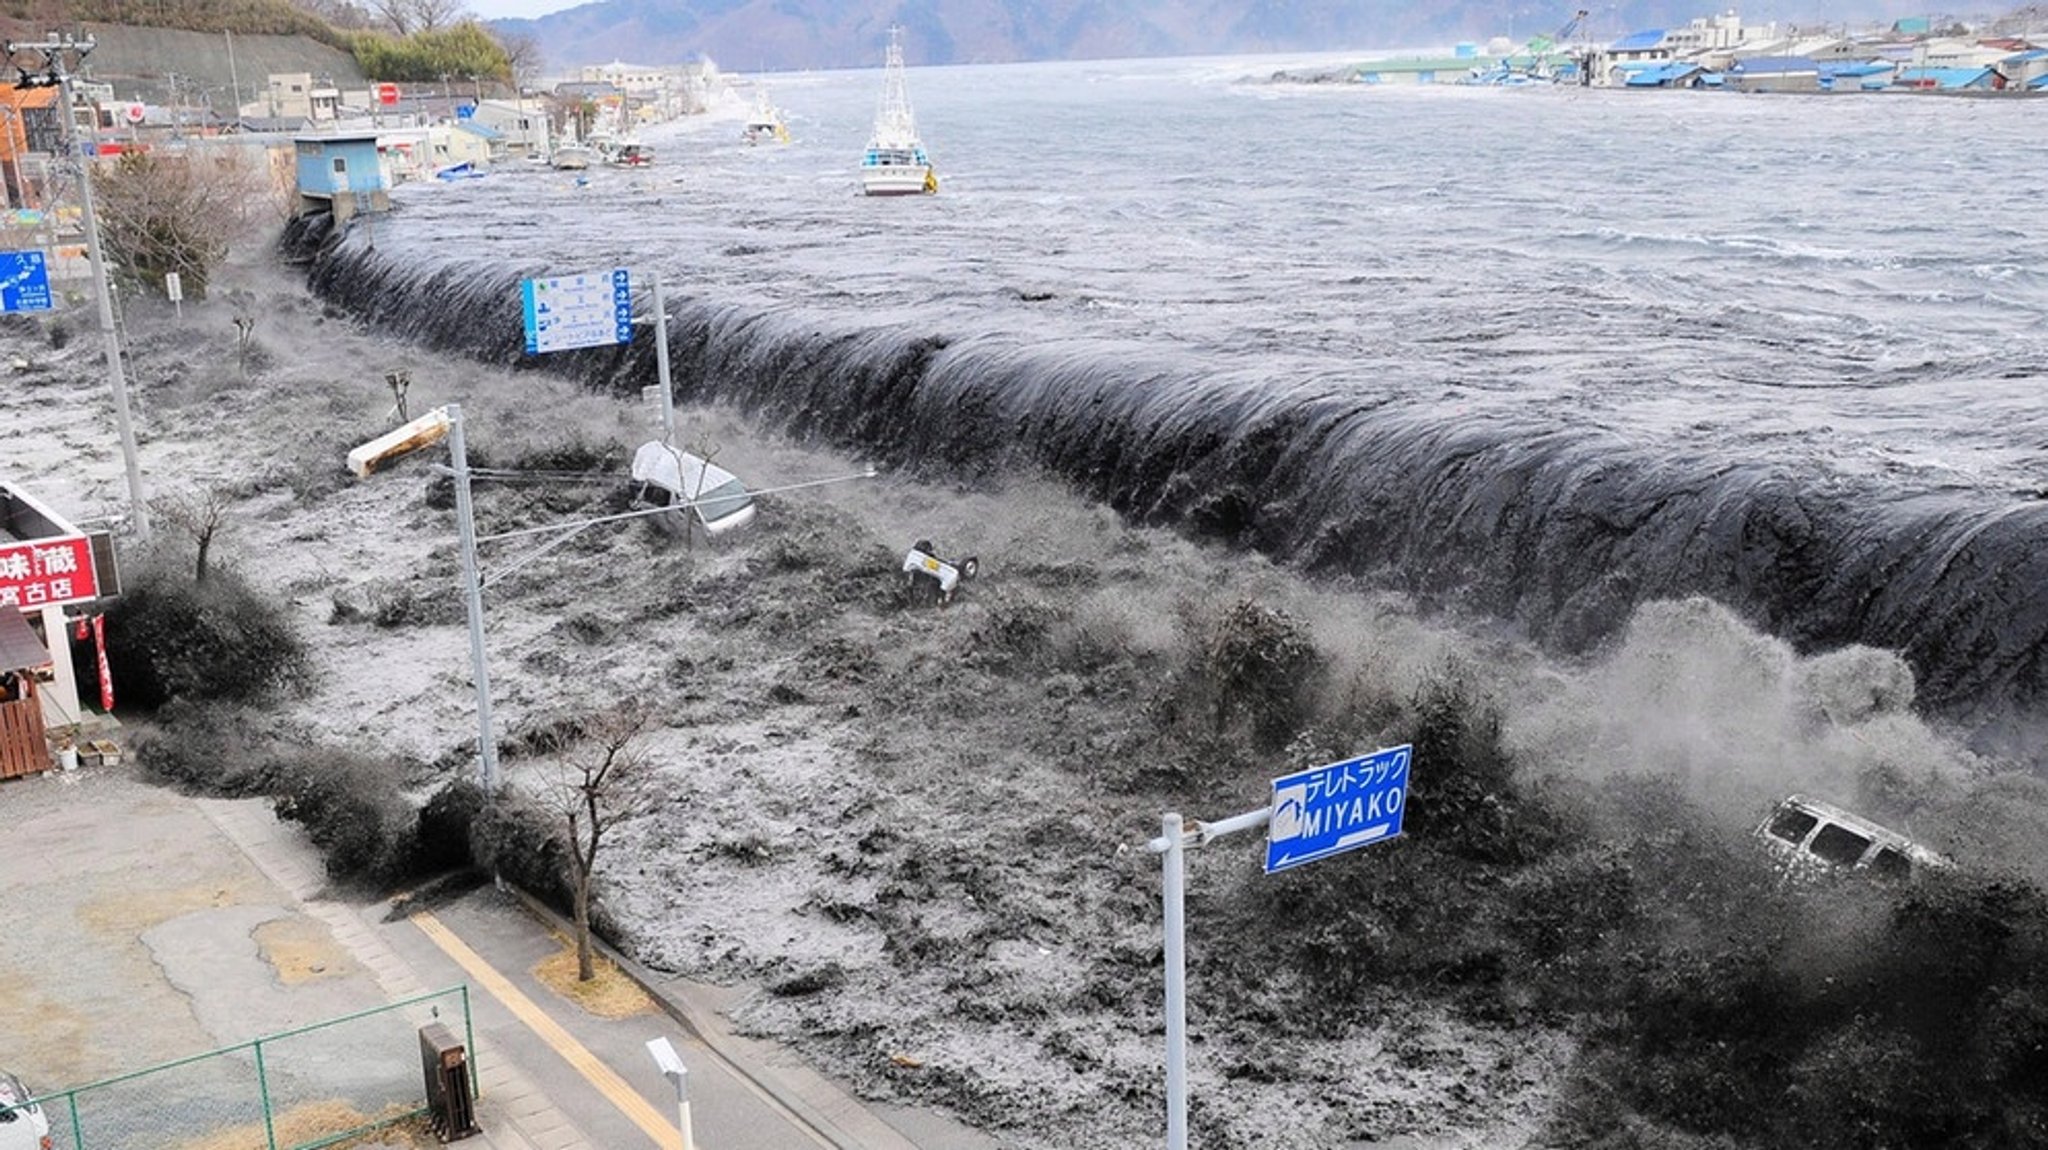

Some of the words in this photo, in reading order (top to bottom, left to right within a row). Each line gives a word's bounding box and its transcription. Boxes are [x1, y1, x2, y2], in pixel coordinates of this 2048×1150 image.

[0, 579, 73, 605] 宮古店
[1308, 752, 1408, 802] テレトラック
[1302, 787, 1401, 839] MIYAKO
